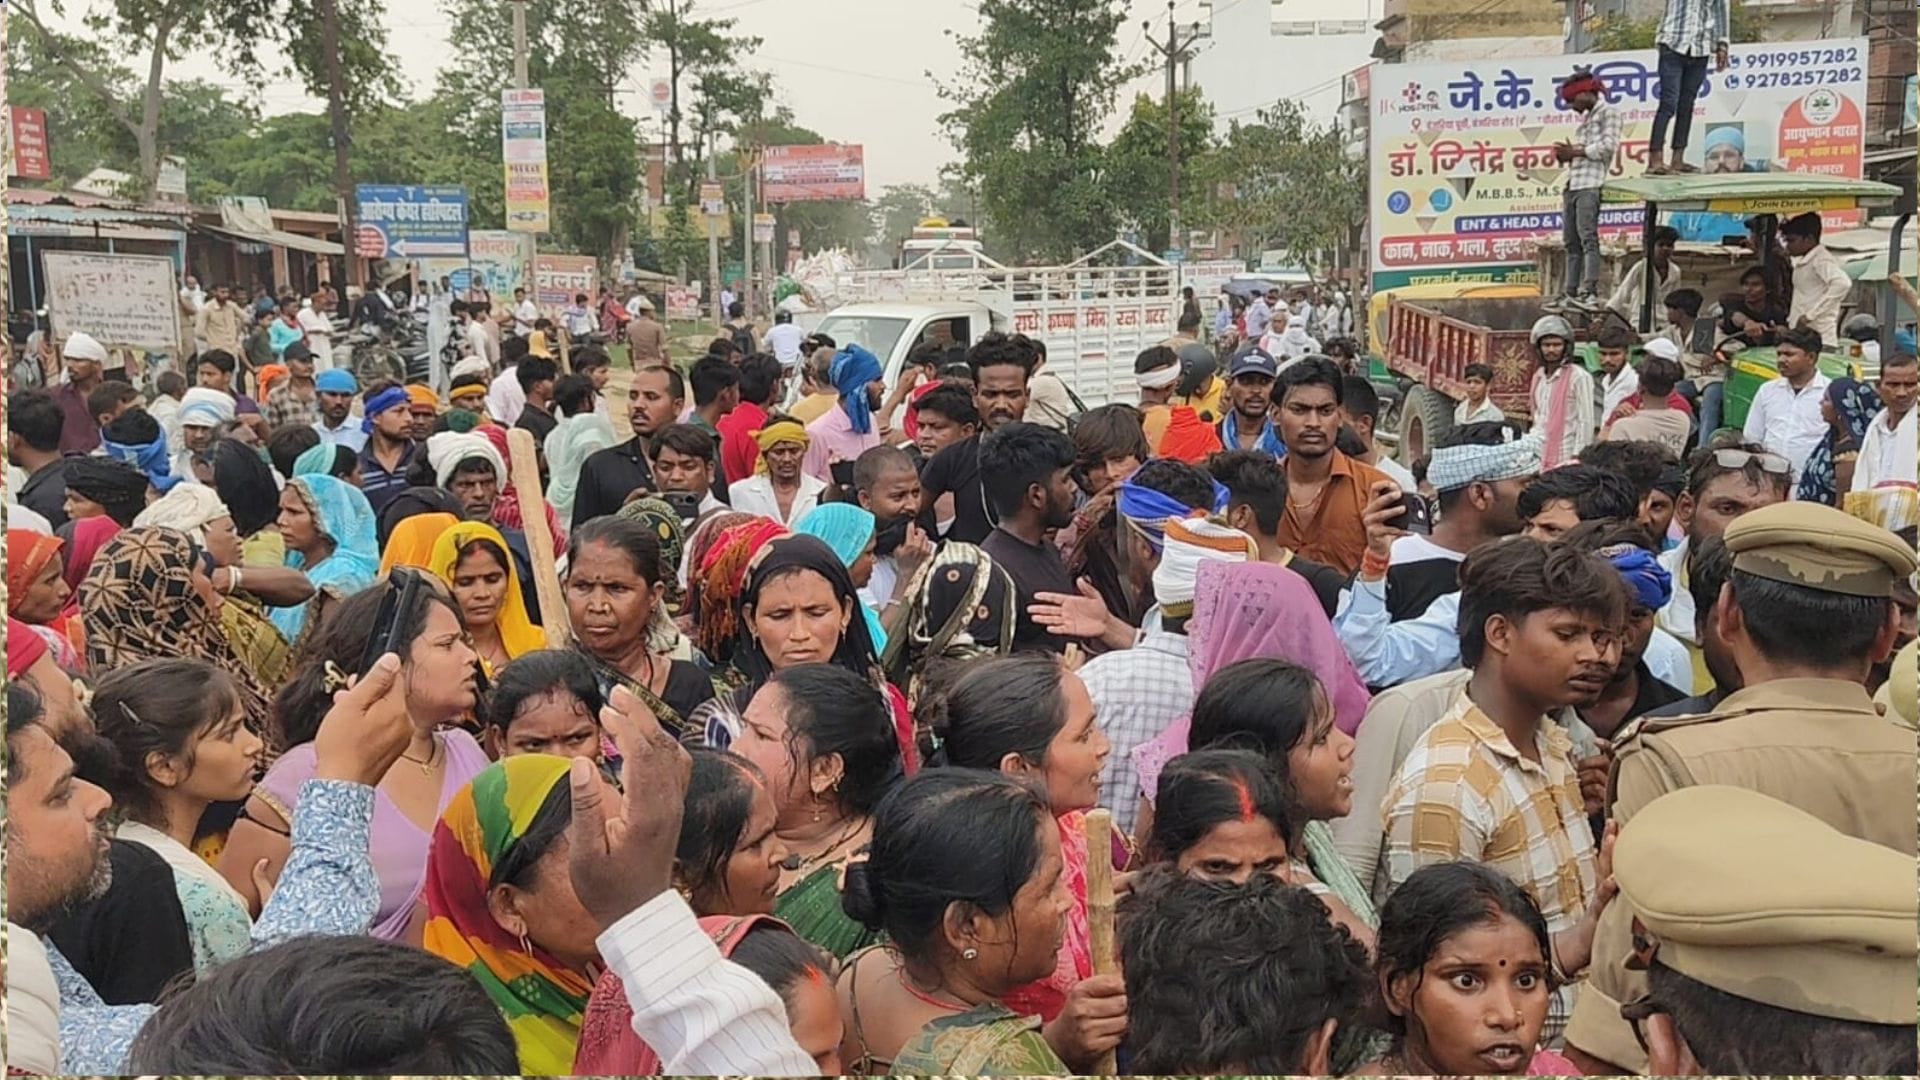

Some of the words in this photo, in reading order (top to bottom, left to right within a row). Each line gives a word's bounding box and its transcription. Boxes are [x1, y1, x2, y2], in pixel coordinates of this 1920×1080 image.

[1745, 47, 1857, 70] 9919957282
[1745, 68, 1861, 90] 9278257282
[1751, 199, 1778, 210] JOHN
[1780, 199, 1818, 209] DEERE
[1461, 218, 1486, 231] ENT
[1490, 218, 1501, 229] &
[1504, 216, 1540, 228] HEAD
[1543, 215, 1552, 227] &
